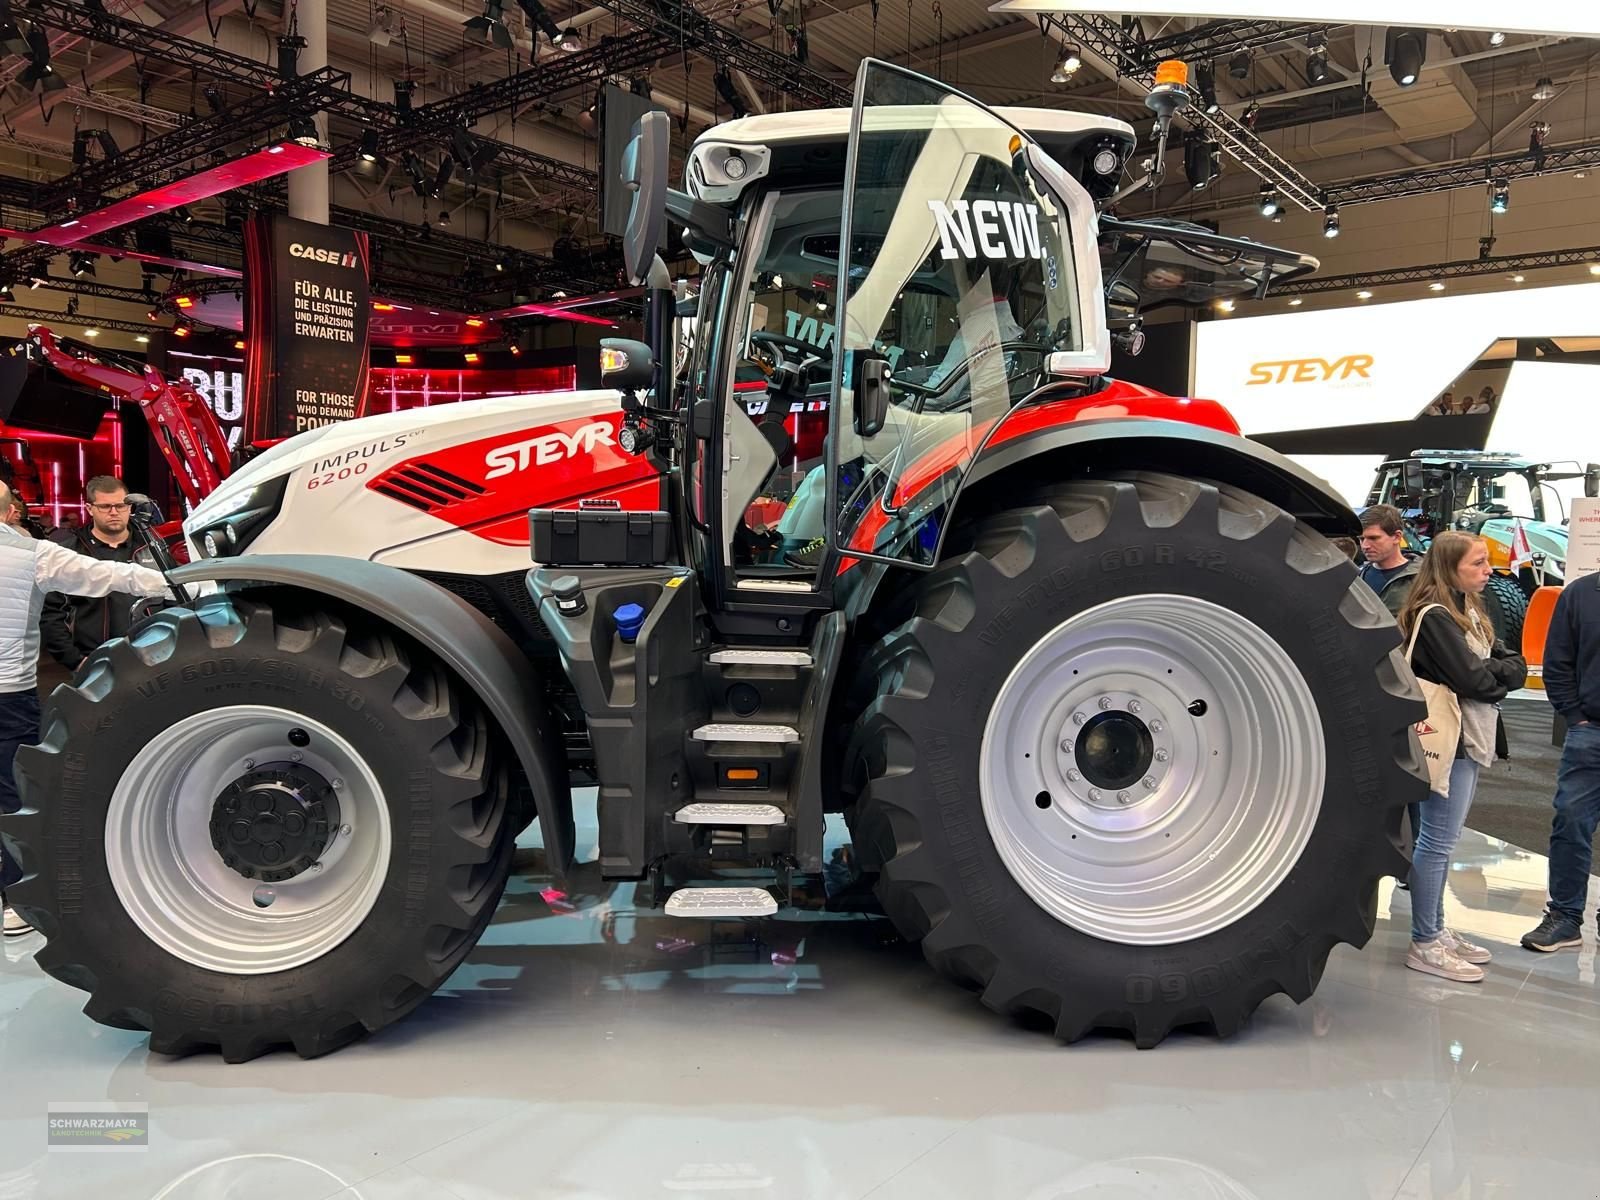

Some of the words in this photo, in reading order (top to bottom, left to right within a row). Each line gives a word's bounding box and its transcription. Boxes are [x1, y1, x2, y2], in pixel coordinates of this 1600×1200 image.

[927, 199, 1048, 260] NEW.
[289, 243, 340, 265] CASE
[294, 280, 320, 299] FÜR
[324, 287, 357, 308] ALLE,
[294, 298, 310, 311] DIE
[312, 301, 353, 318] LEISTUNG
[294, 311, 312, 322] UND
[314, 314, 354, 329] PRÄZISION
[295, 322, 354, 343] ERWARTEN
[1245, 354, 1374, 386] STEYR
[296, 389, 317, 404] FOR
[320, 392, 355, 408] THOSE
[296, 404, 317, 416] WHO
[320, 406, 355, 419] DEMAND
[312, 434, 407, 475] IMPULS
[484, 421, 617, 481] STEYR
[307, 462, 368, 490] 6200
[1424, 749, 1441, 760] HN
